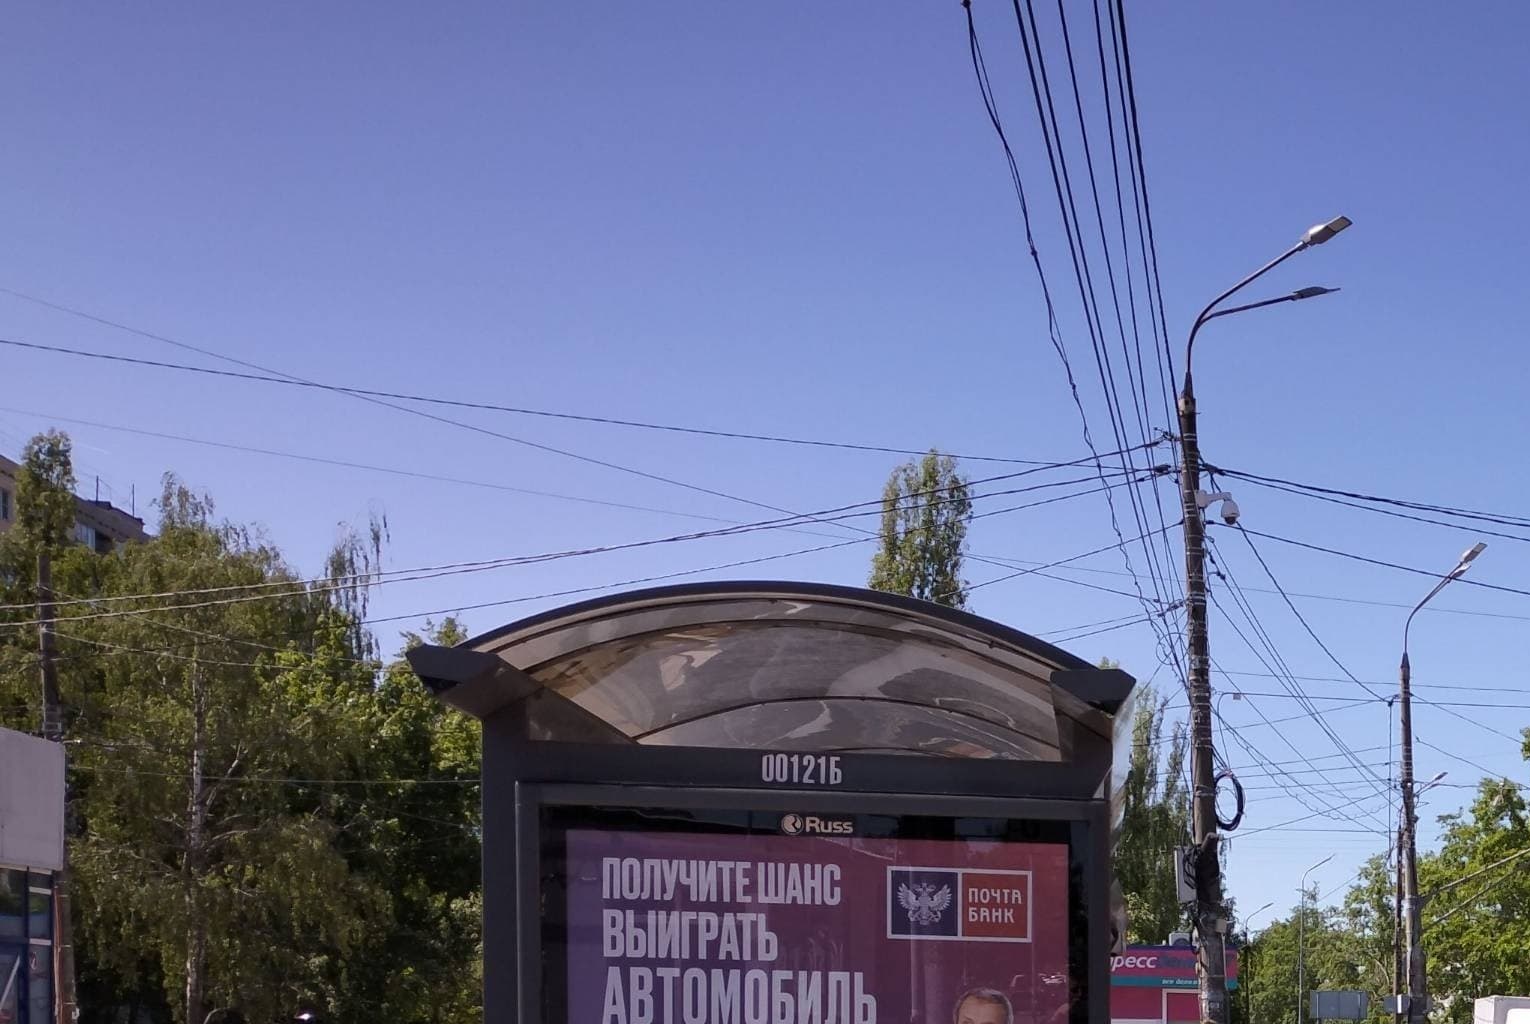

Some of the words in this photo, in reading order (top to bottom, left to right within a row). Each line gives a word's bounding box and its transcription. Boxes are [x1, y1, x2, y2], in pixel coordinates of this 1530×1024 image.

[805, 817, 854, 834] Russ
[602, 857, 752, 903] ПОЛУЧИТЕ
[757, 862, 841, 906] ШАНС
[968, 887, 1022, 905] ПОЧТА
[968, 907, 1015, 923] БАНК
[602, 909, 778, 961] ВЫИГРАТЬ
